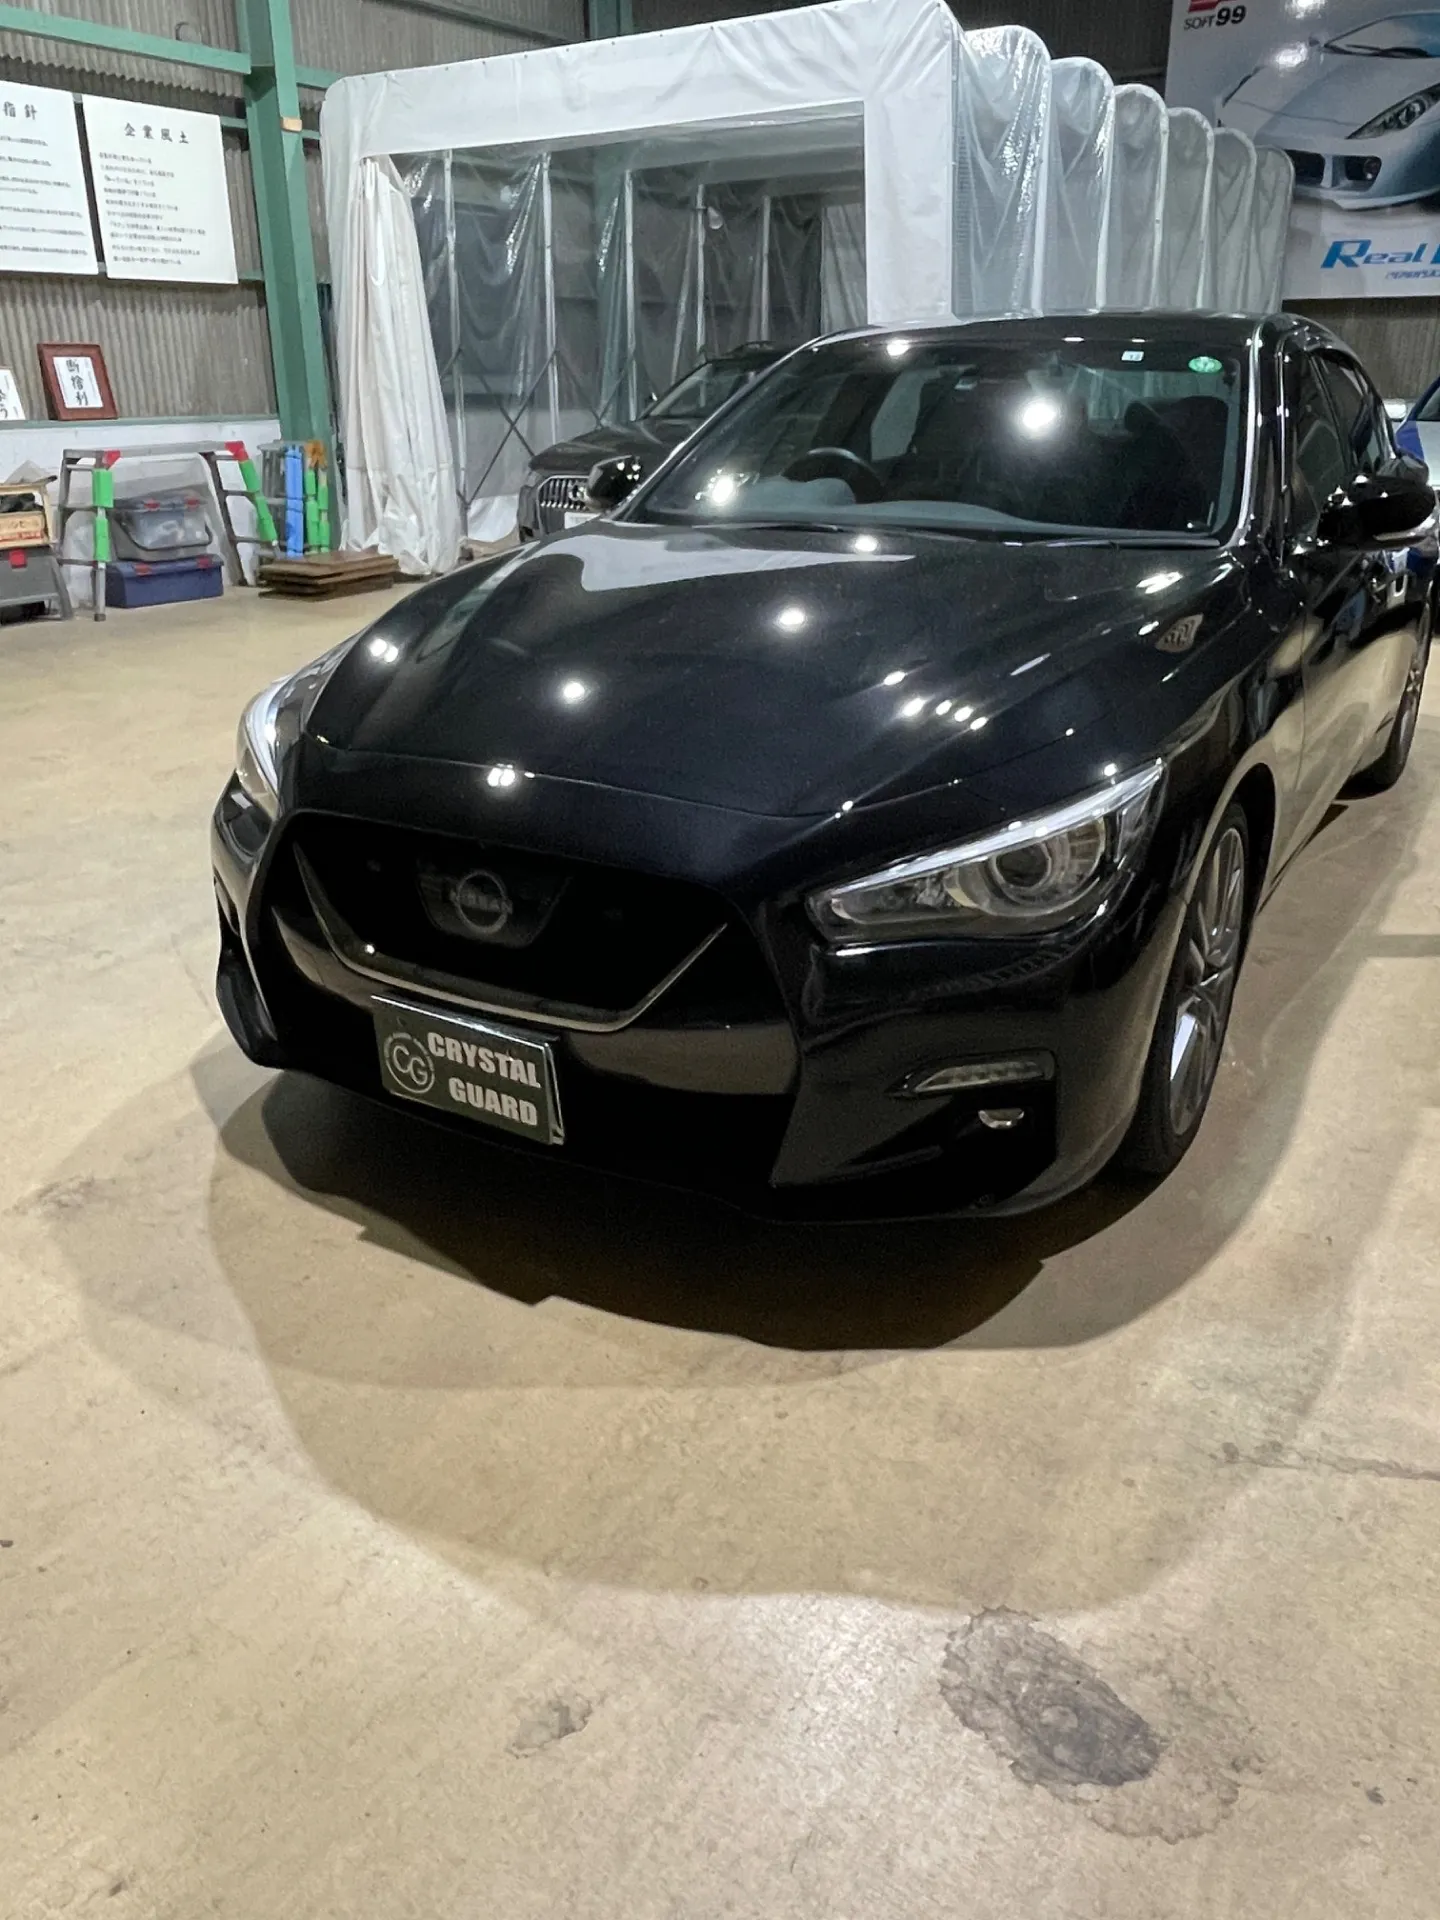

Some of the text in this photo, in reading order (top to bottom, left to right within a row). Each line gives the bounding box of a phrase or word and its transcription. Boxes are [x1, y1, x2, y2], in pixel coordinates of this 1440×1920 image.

[123, 122, 190, 144] 企業風土
[1321, 239, 1428, 268] Real
[427, 1032, 541, 1088] CRYSTAL
[449, 1077, 537, 1126] GUARD
